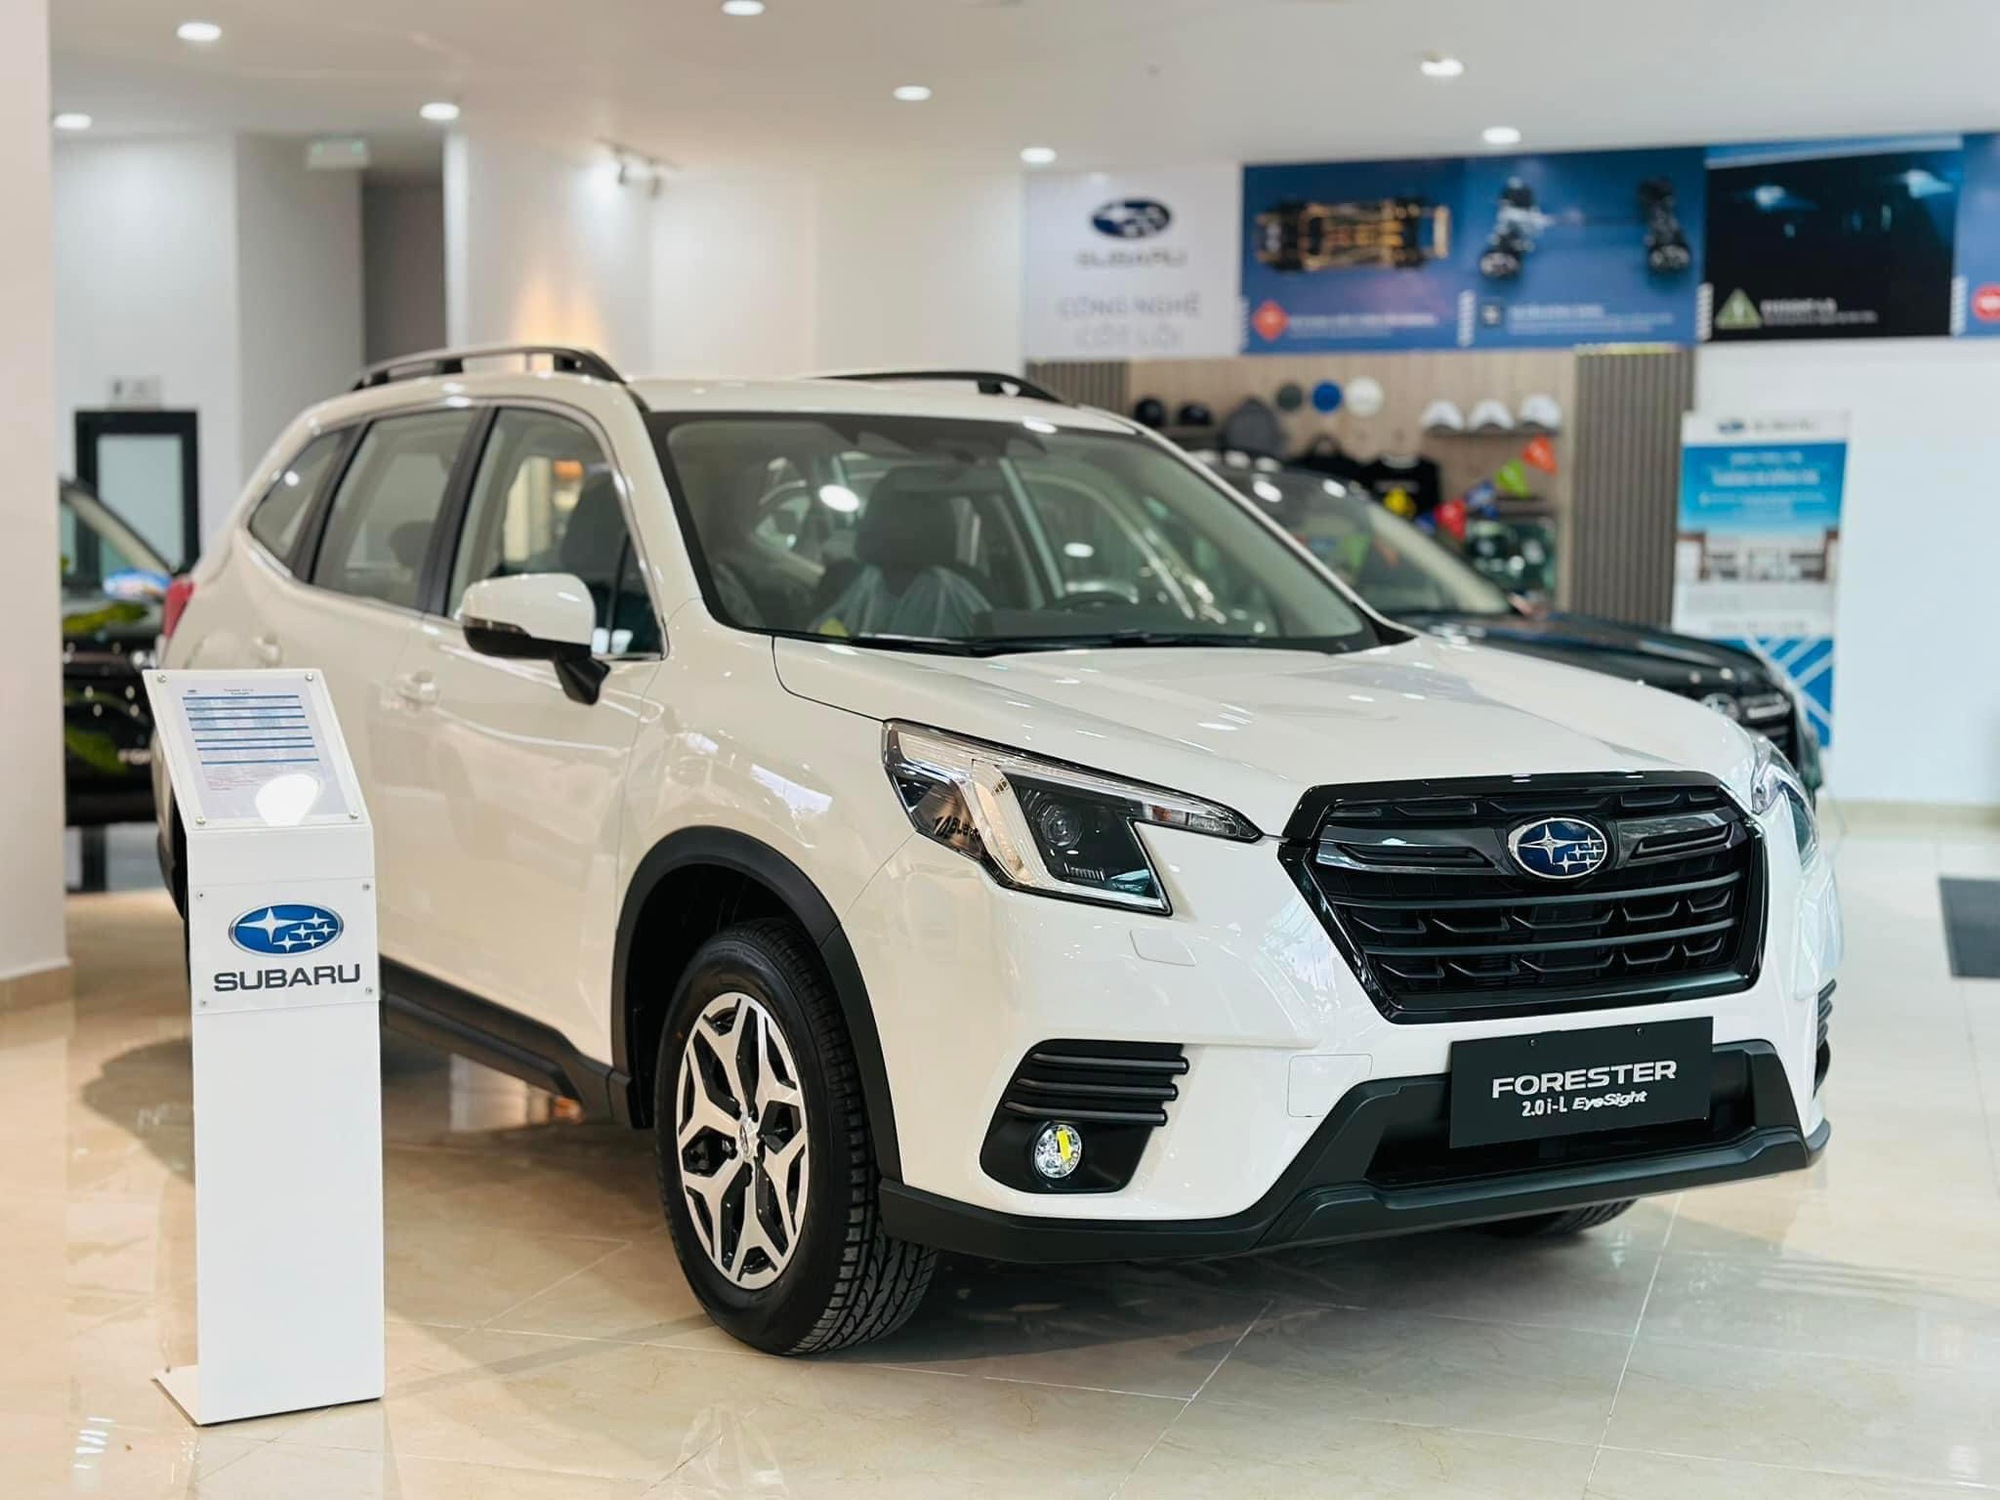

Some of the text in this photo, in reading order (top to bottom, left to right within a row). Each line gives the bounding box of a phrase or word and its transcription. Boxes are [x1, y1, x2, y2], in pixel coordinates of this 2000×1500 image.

[1076, 250, 1188, 268] SUBARU
[214, 964, 361, 993] SUBARU
[1492, 1060, 1677, 1099] FORESTER
[1572, 1090, 1648, 1111] EyeSight
